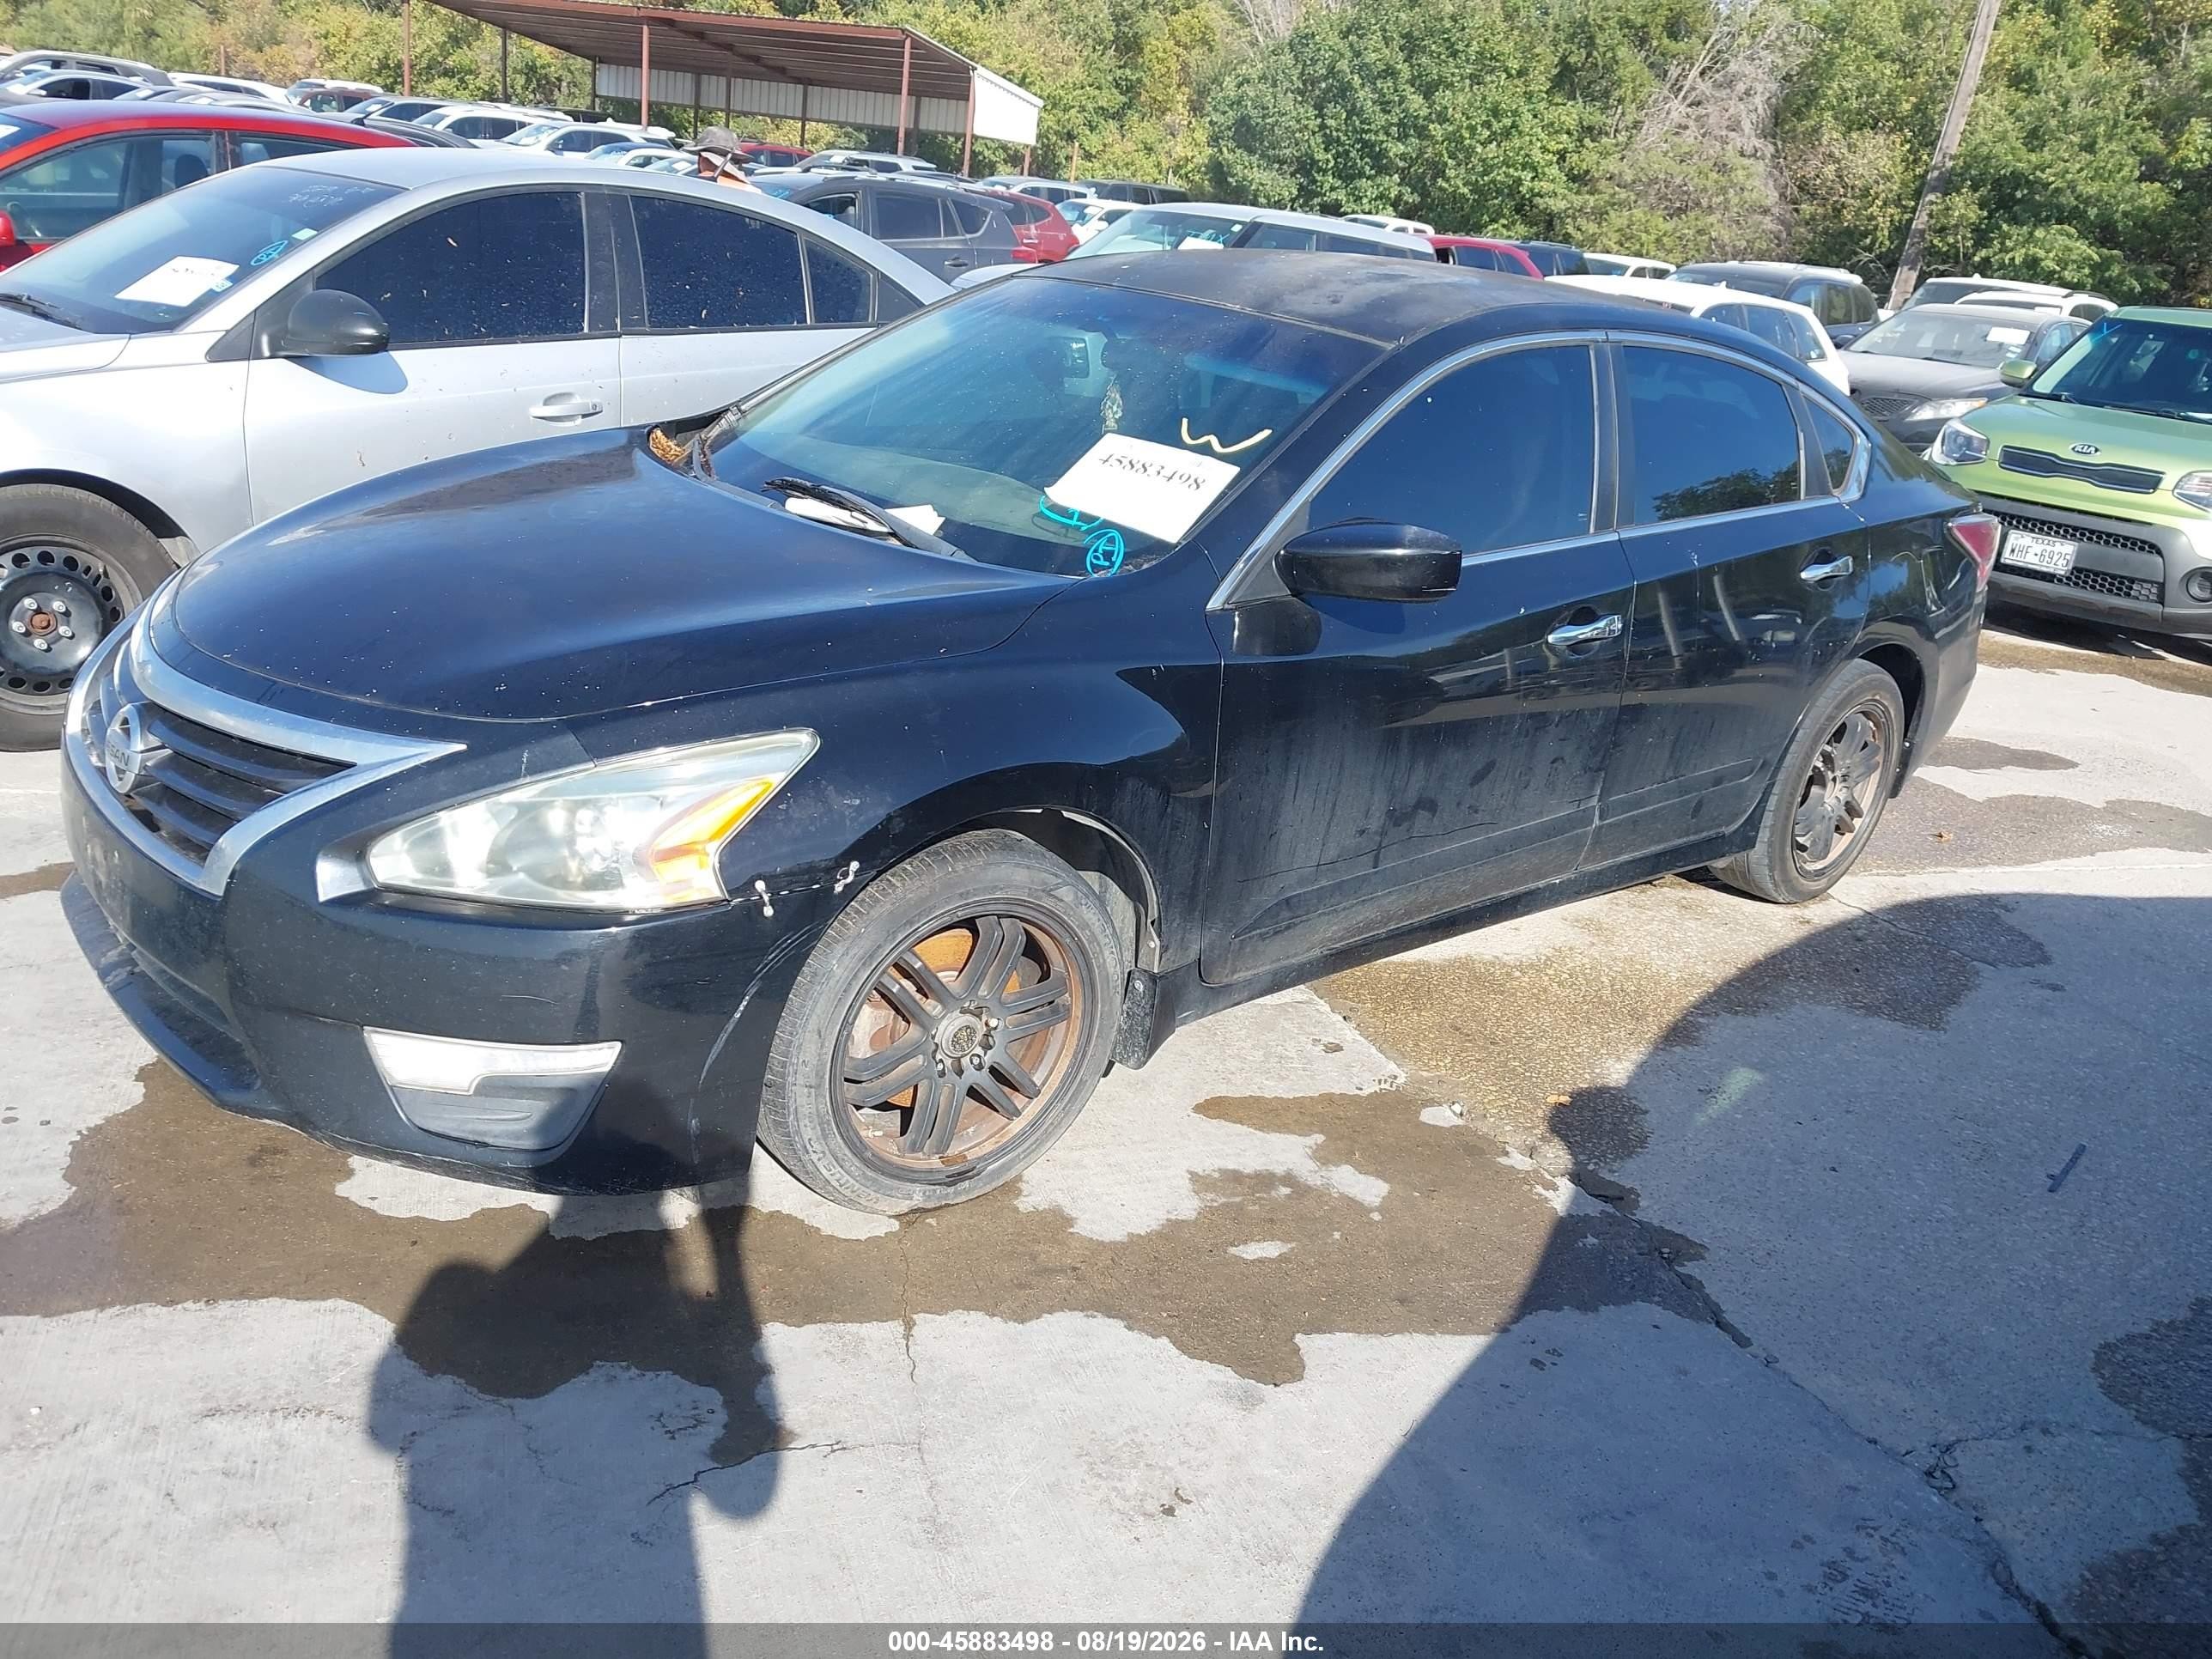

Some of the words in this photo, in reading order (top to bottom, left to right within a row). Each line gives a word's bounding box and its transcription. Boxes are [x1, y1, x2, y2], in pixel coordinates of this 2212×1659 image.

[2074, 444, 2098, 455] KIA
[1098, 452, 1207, 492] 45883498
[2030, 537, 2057, 547] TEXAS
